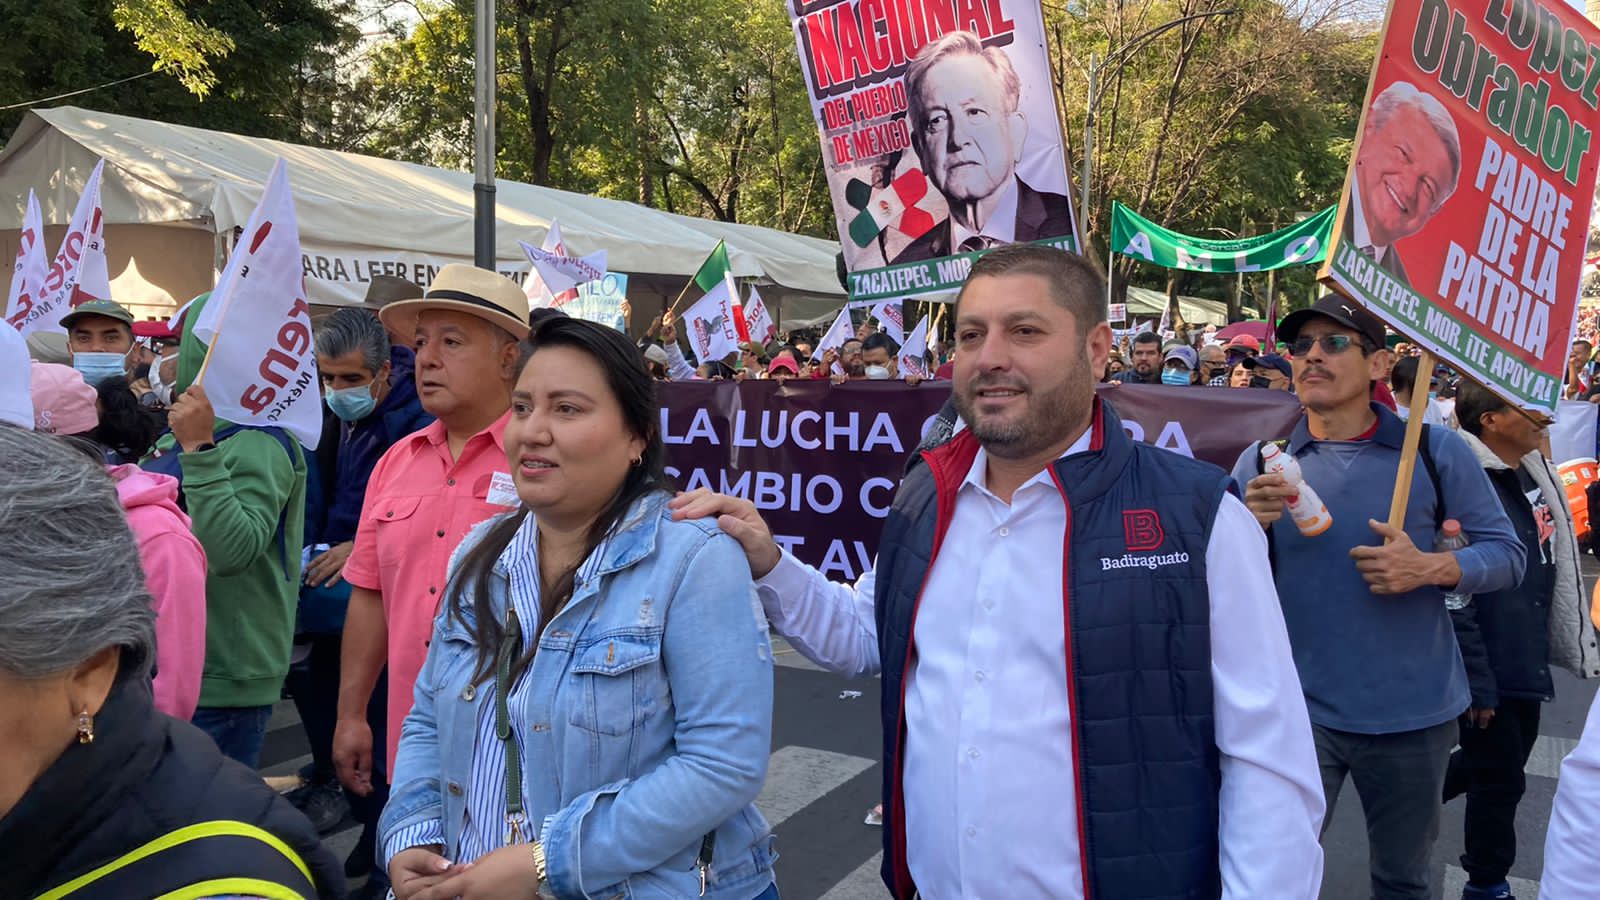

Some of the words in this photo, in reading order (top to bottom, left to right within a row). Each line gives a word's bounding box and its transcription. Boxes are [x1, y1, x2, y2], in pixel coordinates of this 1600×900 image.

[806, 0, 1015, 89] NACIONAL
[824, 97, 852, 129] DEL
[851, 80, 909, 122] PUEBLO
[1412, 0, 1592, 186] Obrador
[832, 134, 853, 164] DE
[1474, 136, 1573, 250] PADRE
[302, 254, 350, 282] ARA
[1478, 203, 1523, 277] DE
[1520, 233, 1560, 304] LA
[852, 264, 937, 296] ZACATEPEC,
[1337, 241, 1420, 327] ZACATEPEC,
[1424, 306, 1461, 352] MOR.
[1438, 240, 1550, 360] PATRIA
[660, 407, 720, 445] LA
[733, 409, 904, 453] LUCHA
[664, 467, 843, 514] AMBIO
[1100, 552, 1189, 571] Badiraguato
